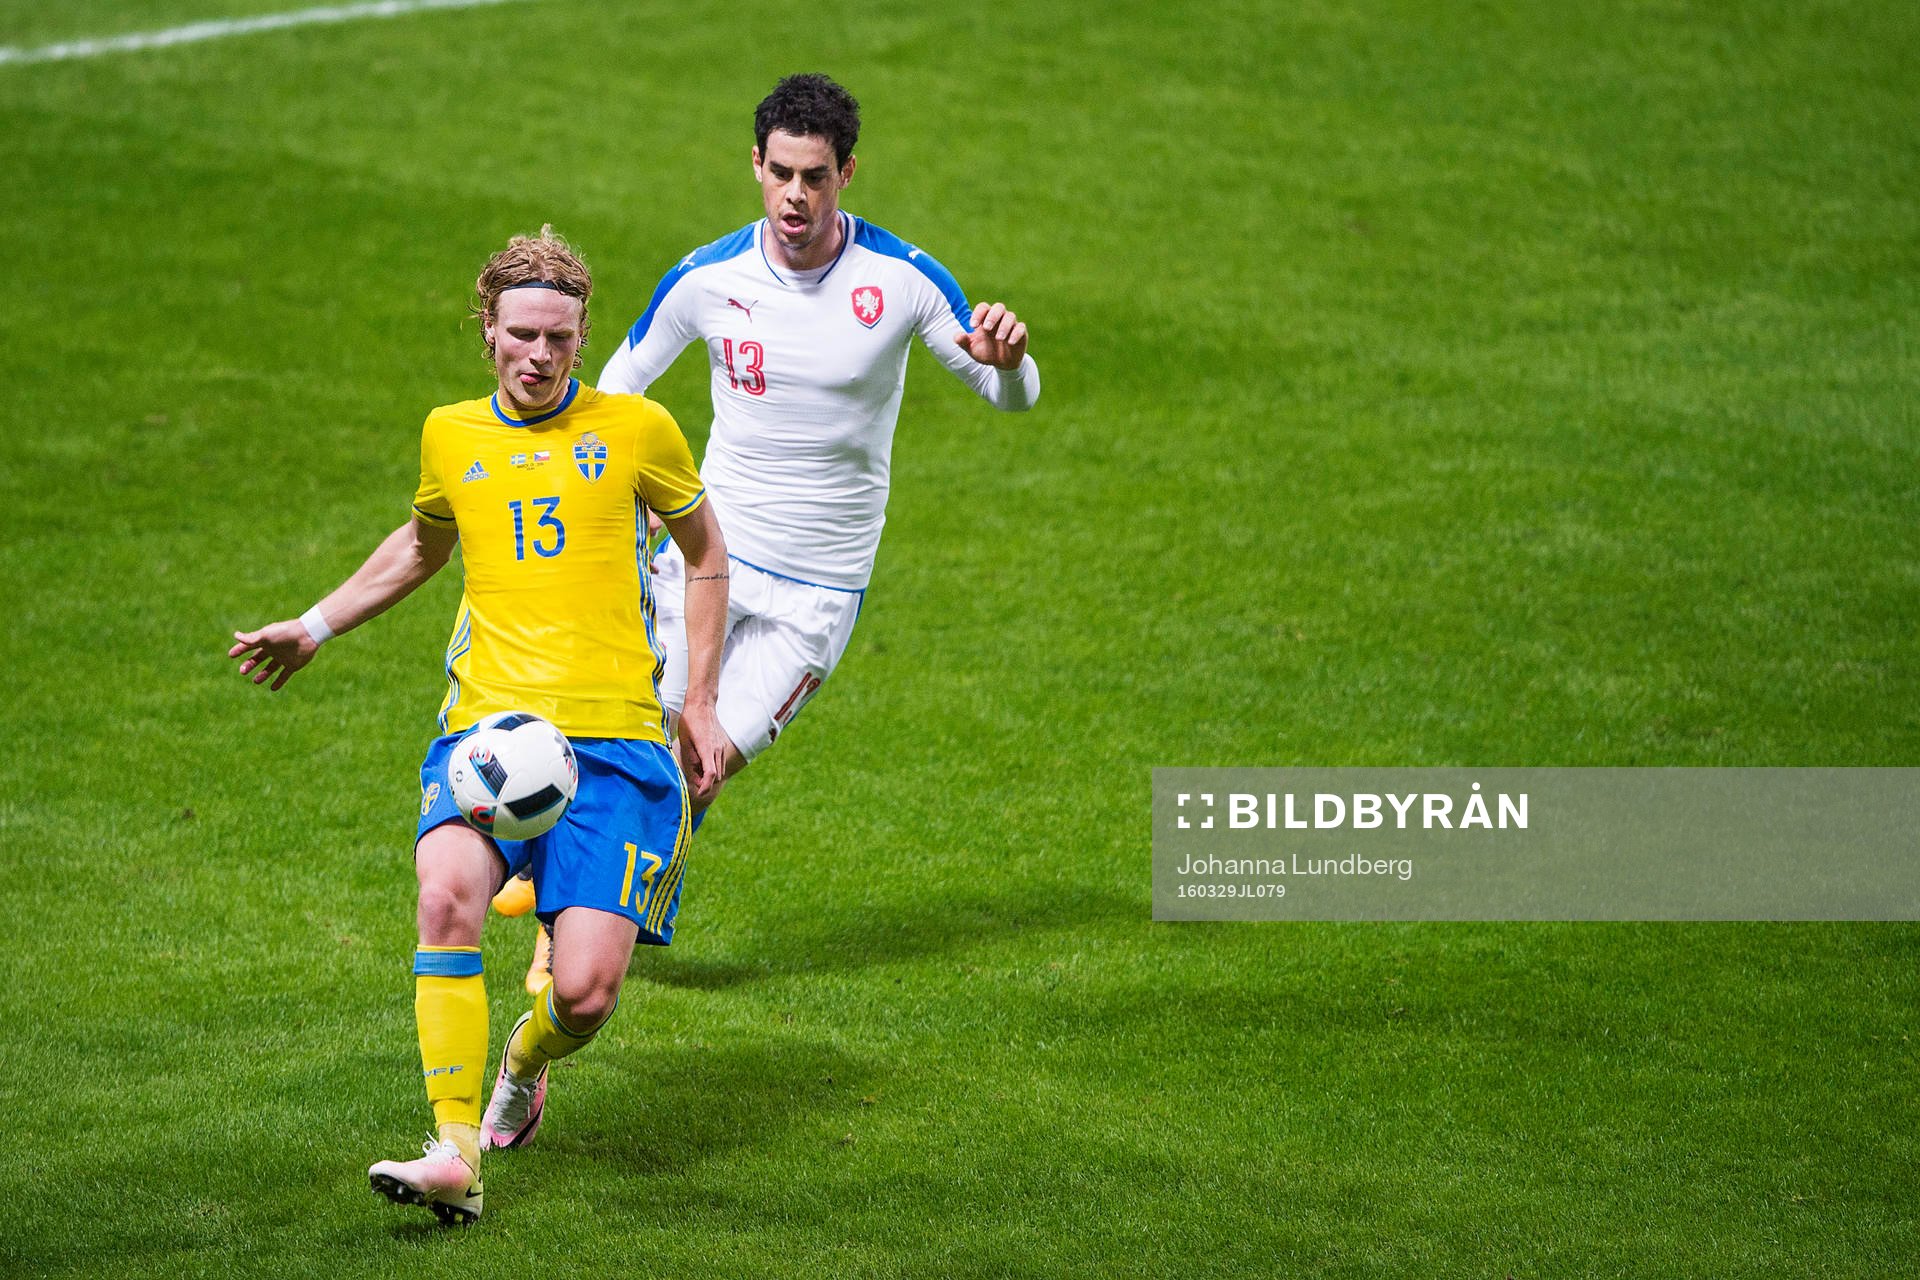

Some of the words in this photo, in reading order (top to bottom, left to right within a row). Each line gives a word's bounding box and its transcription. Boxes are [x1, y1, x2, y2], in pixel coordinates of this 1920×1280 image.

[723, 338, 766, 396] 13
[462, 471, 489, 483] adidas
[508, 496, 566, 561] 13
[618, 842, 662, 915] 13
